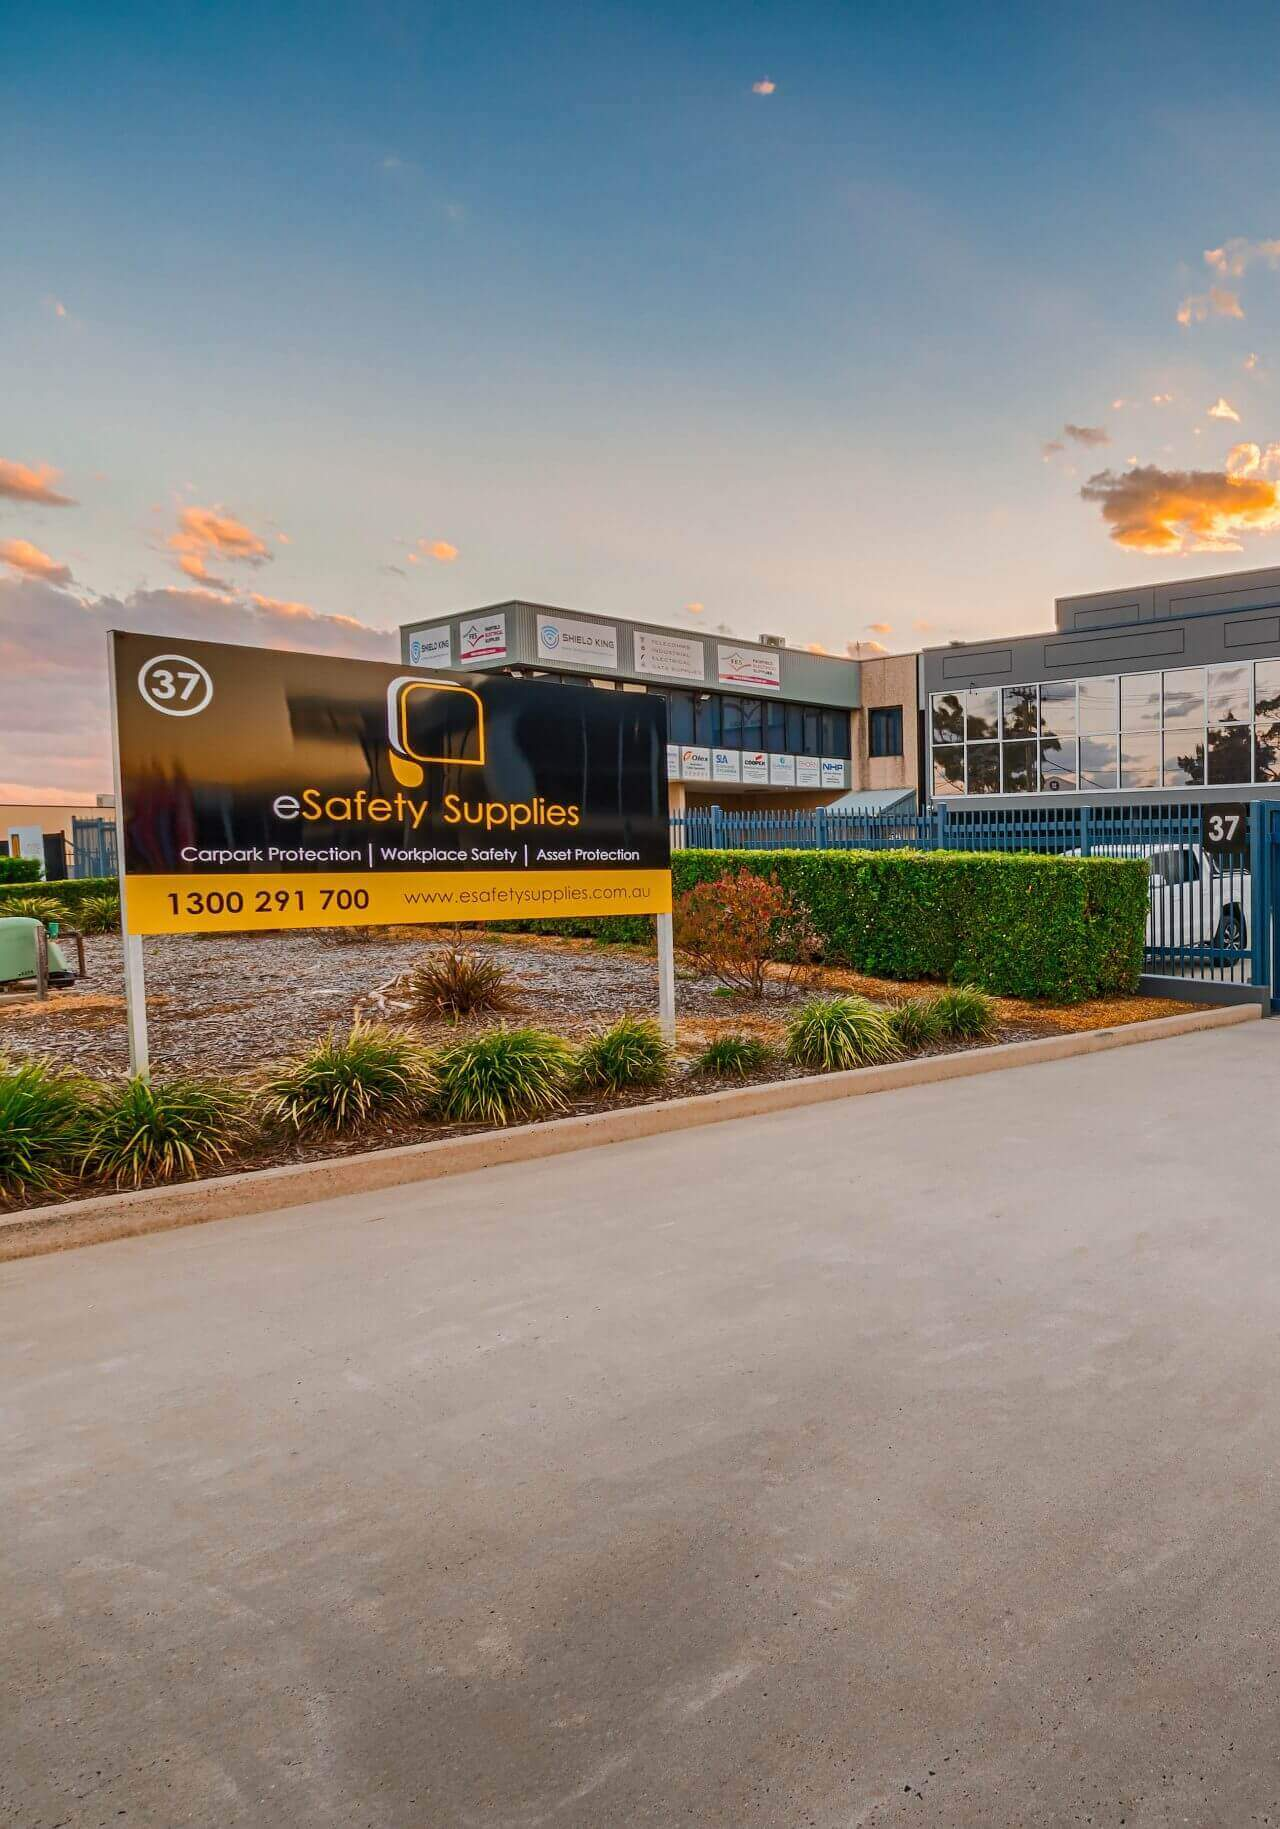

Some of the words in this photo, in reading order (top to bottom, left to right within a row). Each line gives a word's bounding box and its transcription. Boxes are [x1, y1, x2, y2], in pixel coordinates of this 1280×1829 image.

[562, 633, 592, 646] SHIELD
[594, 638, 615, 649] KING
[151, 669, 200, 701] 37
[823, 763, 843, 771] NHP
[273, 789, 428, 829] eSafety
[443, 794, 580, 831] Supplies
[1208, 815, 1240, 842] 37
[181, 847, 263, 864] Carpark
[268, 847, 361, 862] Protection
[380, 848, 468, 863] Workplace
[471, 848, 517, 863] Safety
[536, 849, 571, 861] Asset
[575, 848, 640, 861] Protection
[167, 891, 244, 915] 1300
[255, 890, 305, 913] 291
[320, 888, 369, 911] 700
[404, 886, 650, 905] www.esafetysupplies.com.au
